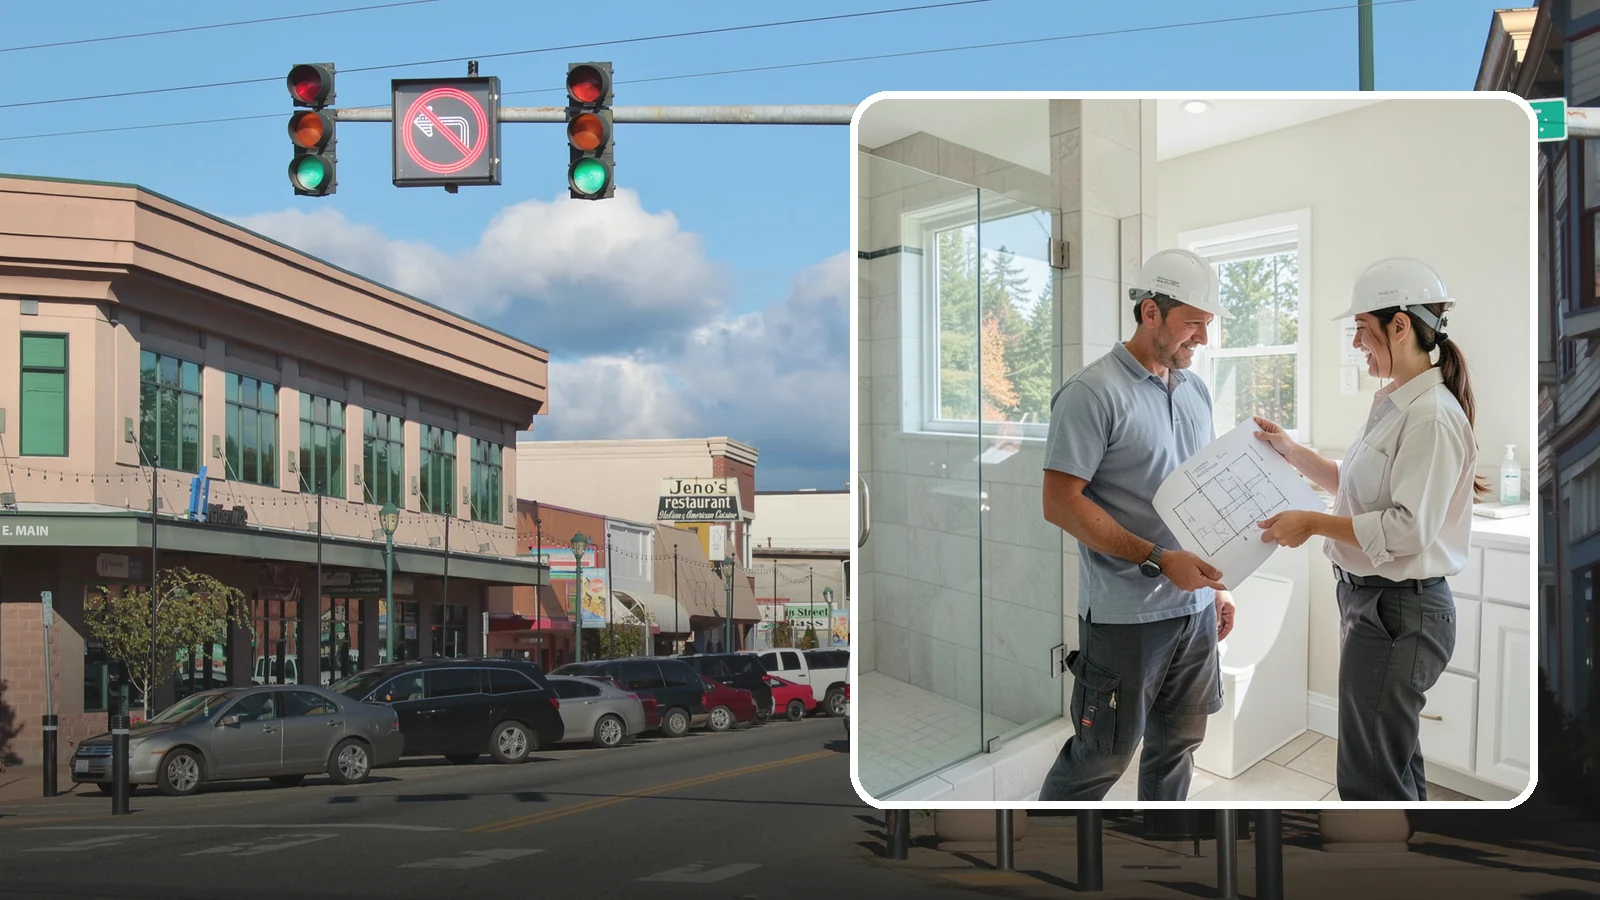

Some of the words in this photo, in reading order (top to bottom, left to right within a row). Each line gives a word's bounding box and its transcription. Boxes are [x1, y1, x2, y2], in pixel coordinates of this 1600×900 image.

[669, 480, 728, 495] Jeno's
[665, 496, 731, 509] restaurant
[686, 509, 714, 519] American
[715, 509, 738, 519] Cuisine
[2, 525, 13, 536] E.
[15, 525, 49, 536] MAIN
[797, 607, 829, 617] Street
